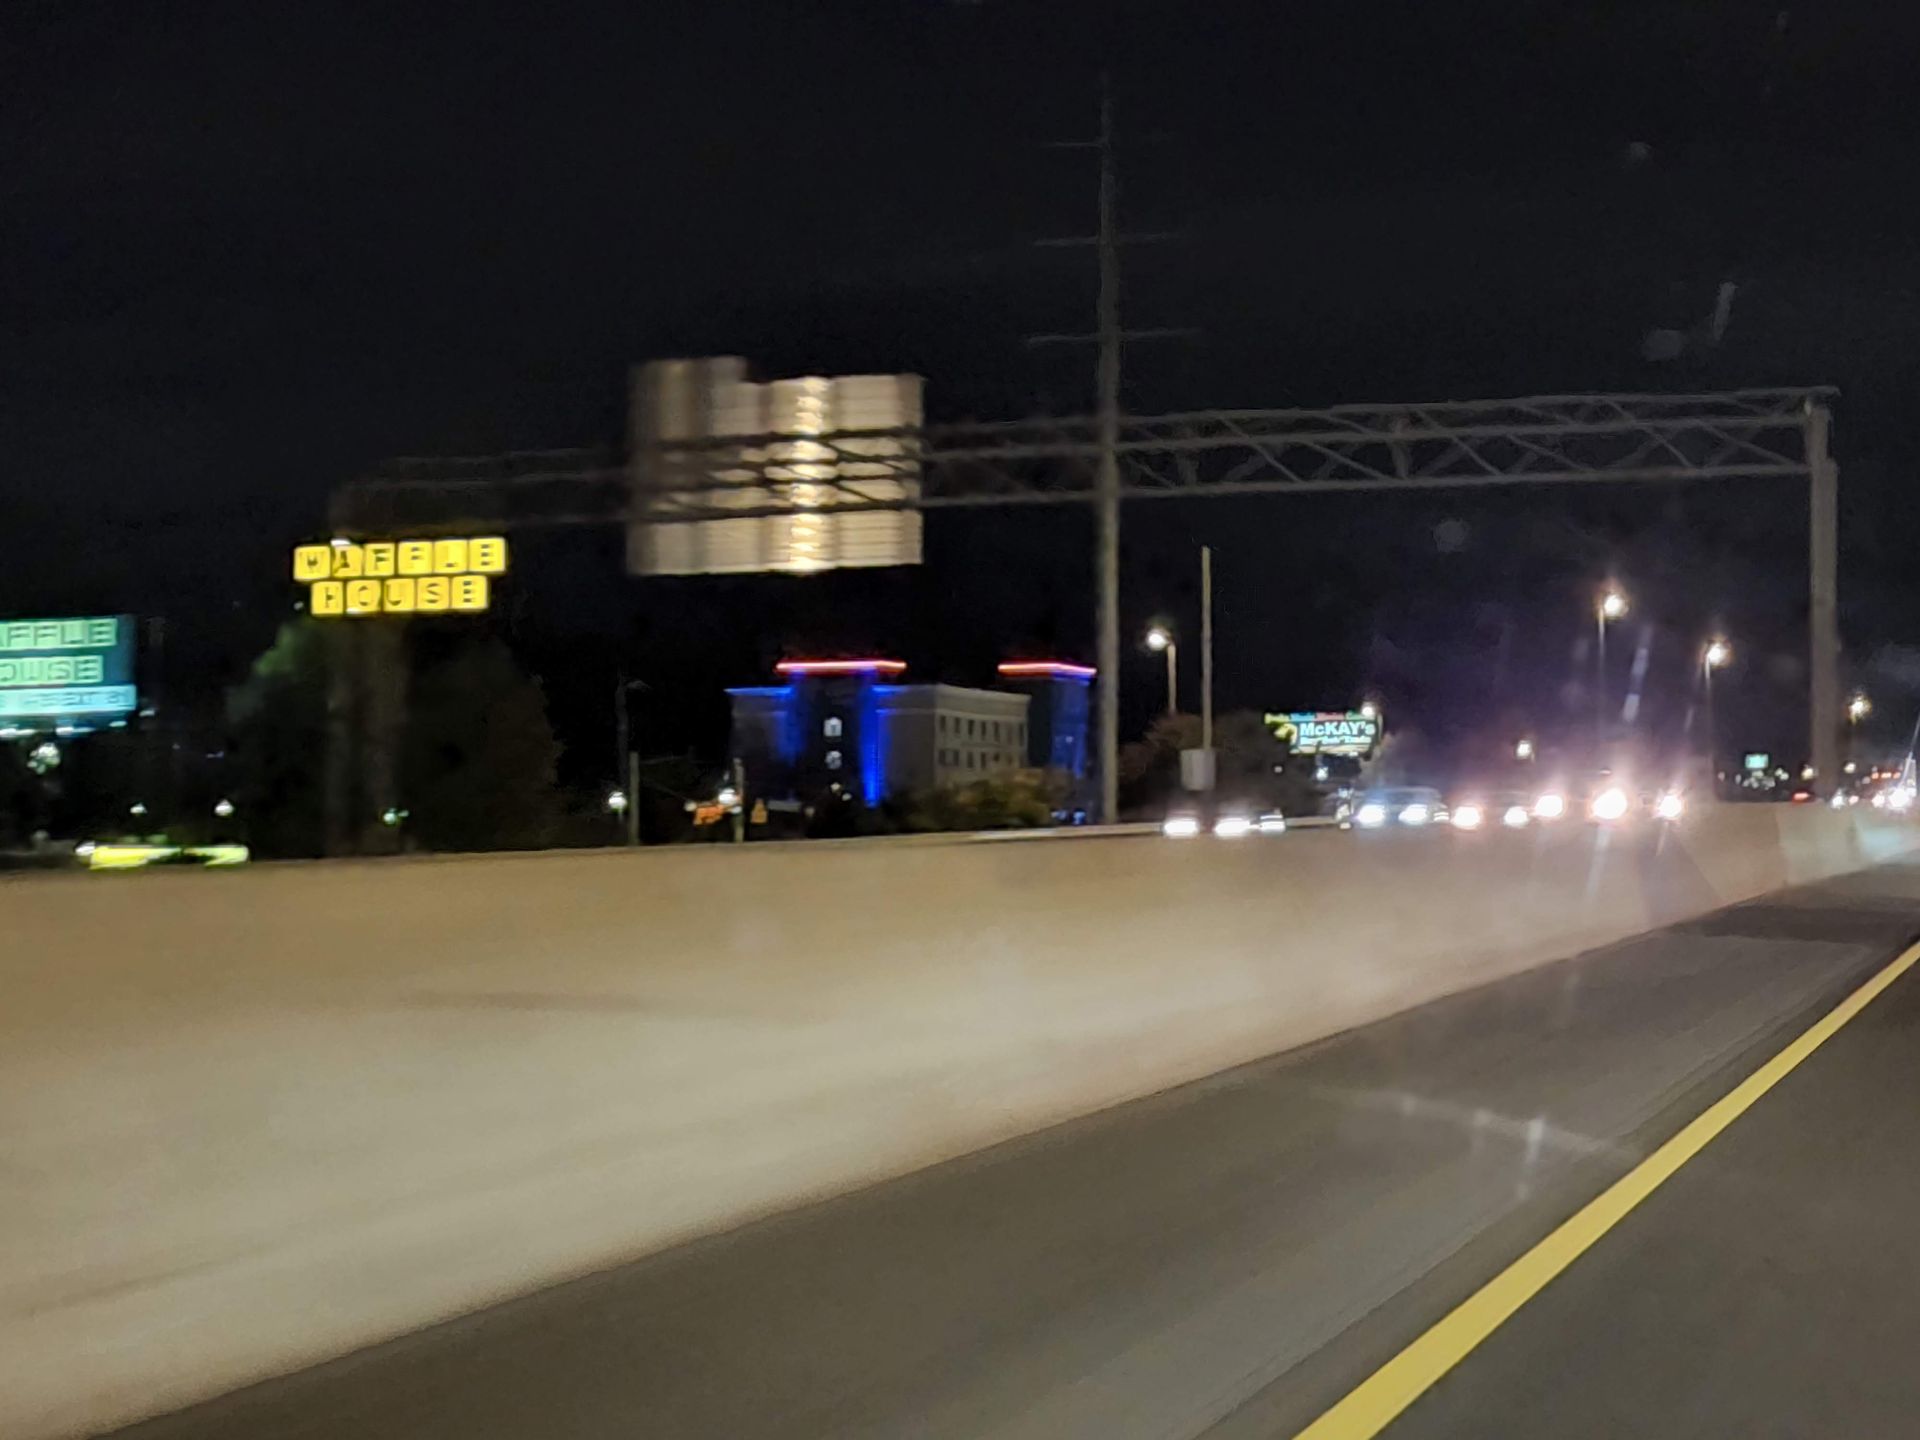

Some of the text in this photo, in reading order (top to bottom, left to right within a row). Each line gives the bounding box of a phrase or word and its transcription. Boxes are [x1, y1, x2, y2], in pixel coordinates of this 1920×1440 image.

[296, 540, 503, 577] WAFFLE
[314, 577, 482, 611] HOUSE
[0, 620, 113, 648] FFLE
[1300, 721, 1375, 736] McKAY's
